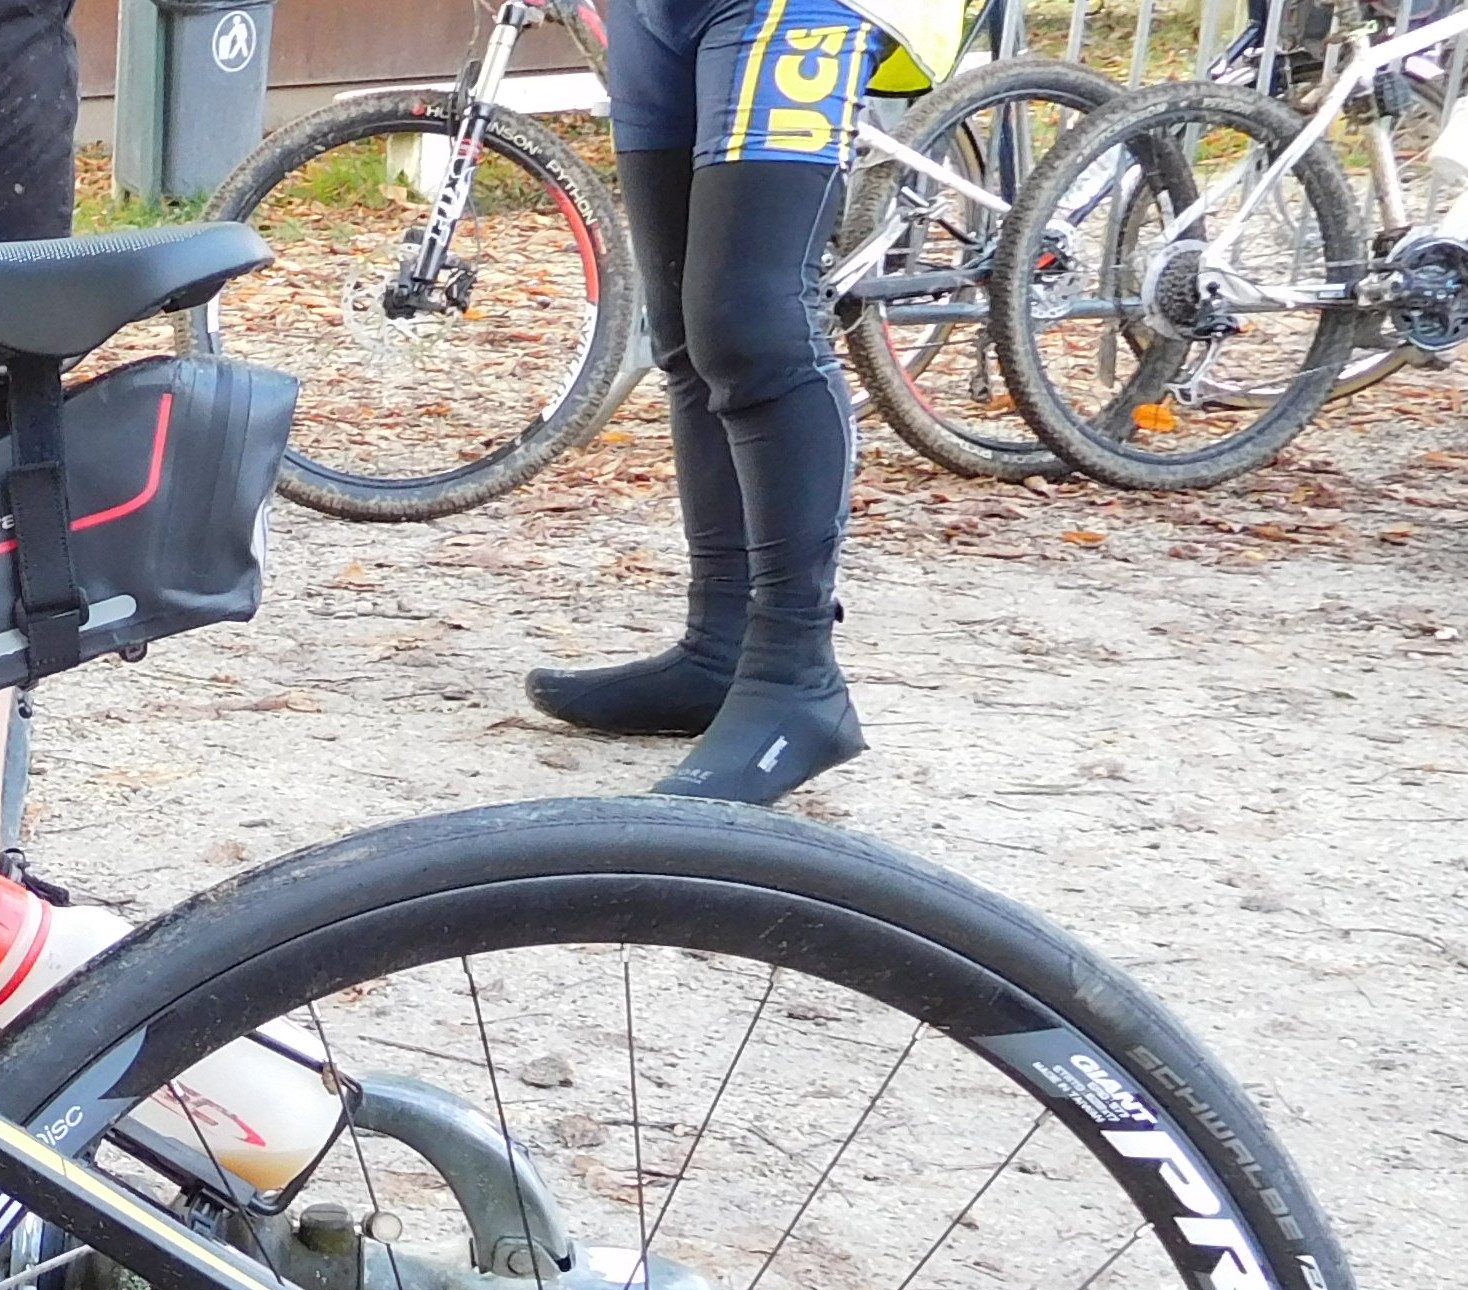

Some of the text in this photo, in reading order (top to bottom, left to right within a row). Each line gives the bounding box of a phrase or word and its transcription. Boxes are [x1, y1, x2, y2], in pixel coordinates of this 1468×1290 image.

[765, 26, 850, 152] UCS
[546, 160, 598, 226] PYTHON
[1070, 1054, 1158, 1124] GIANT
[1125, 1045, 1305, 1243] SCHWALBE
